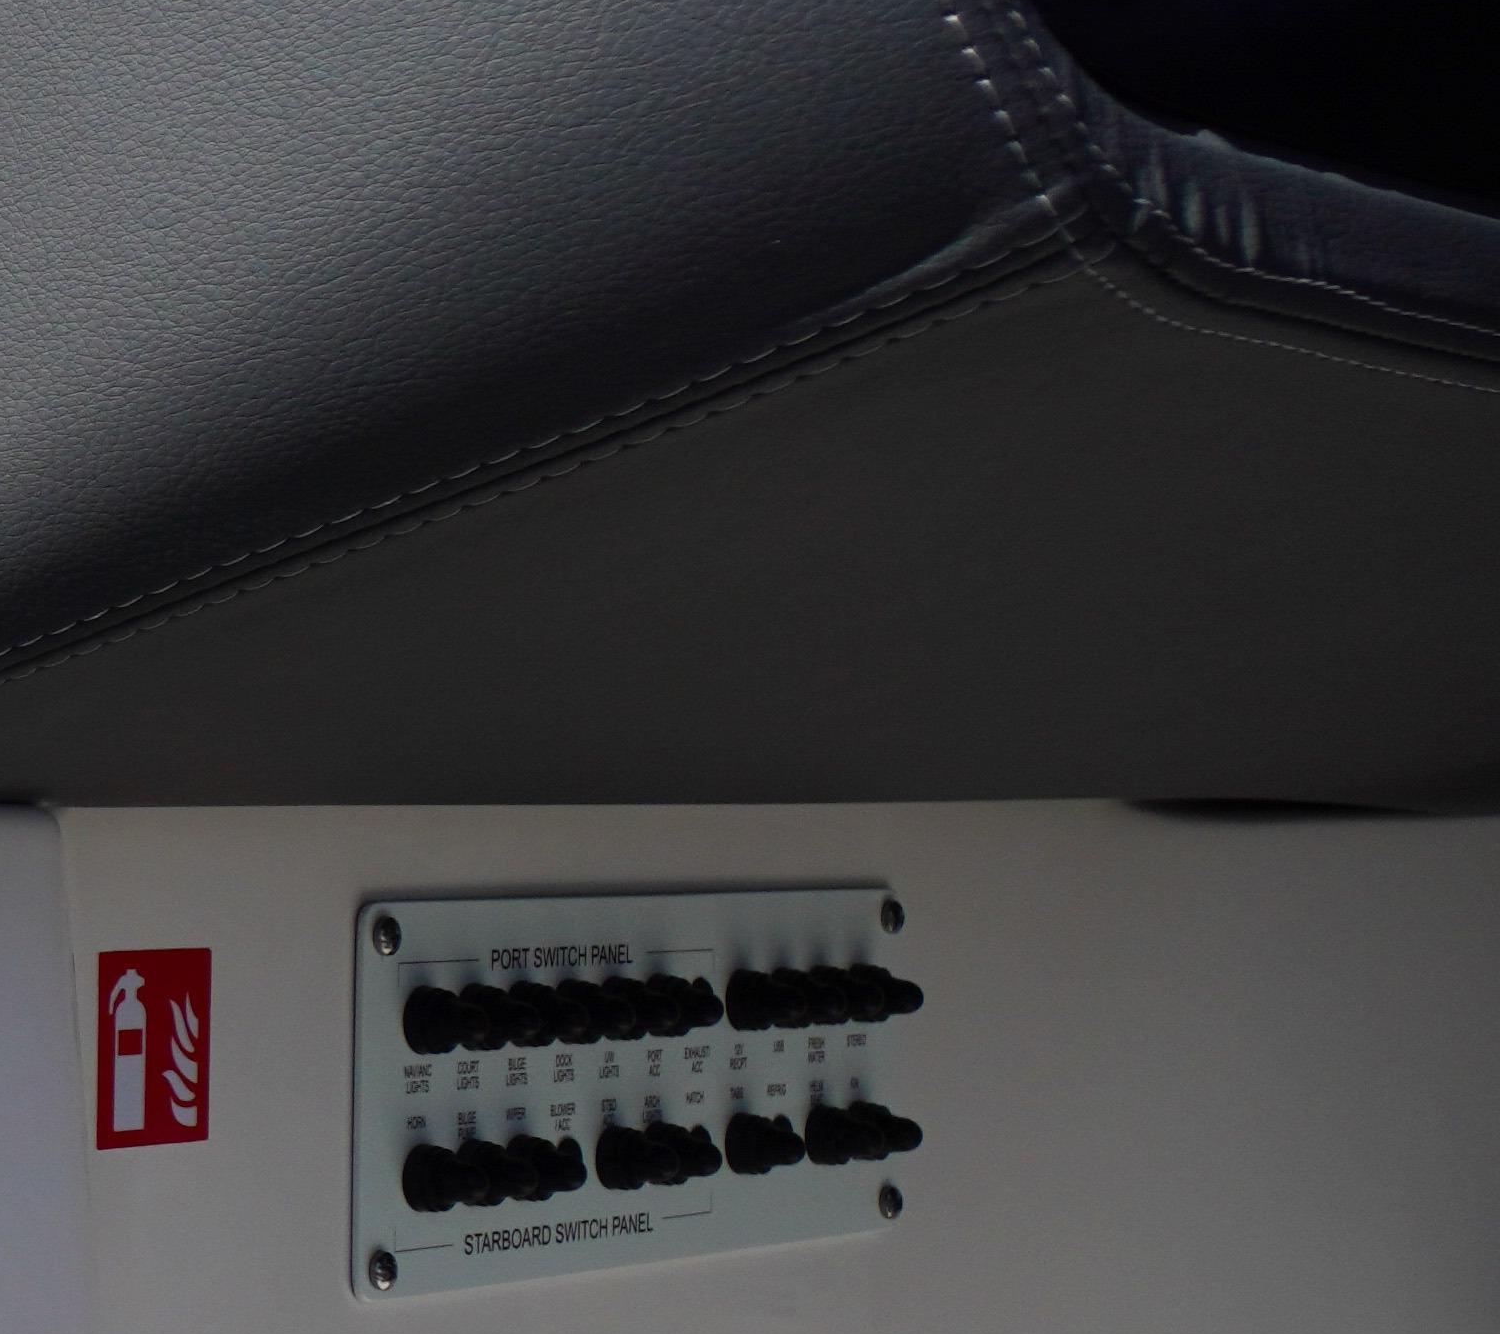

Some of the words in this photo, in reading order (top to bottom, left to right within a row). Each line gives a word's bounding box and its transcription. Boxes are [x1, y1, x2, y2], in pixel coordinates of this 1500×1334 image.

[491, 948, 530, 971] PORT
[534, 946, 587, 968] SWITCH
[591, 944, 633, 965] PANEL
[464, 1225, 552, 1255] STARBOARD
[556, 1218, 608, 1244] SWITCH
[612, 1213, 654, 1236] PANEL
